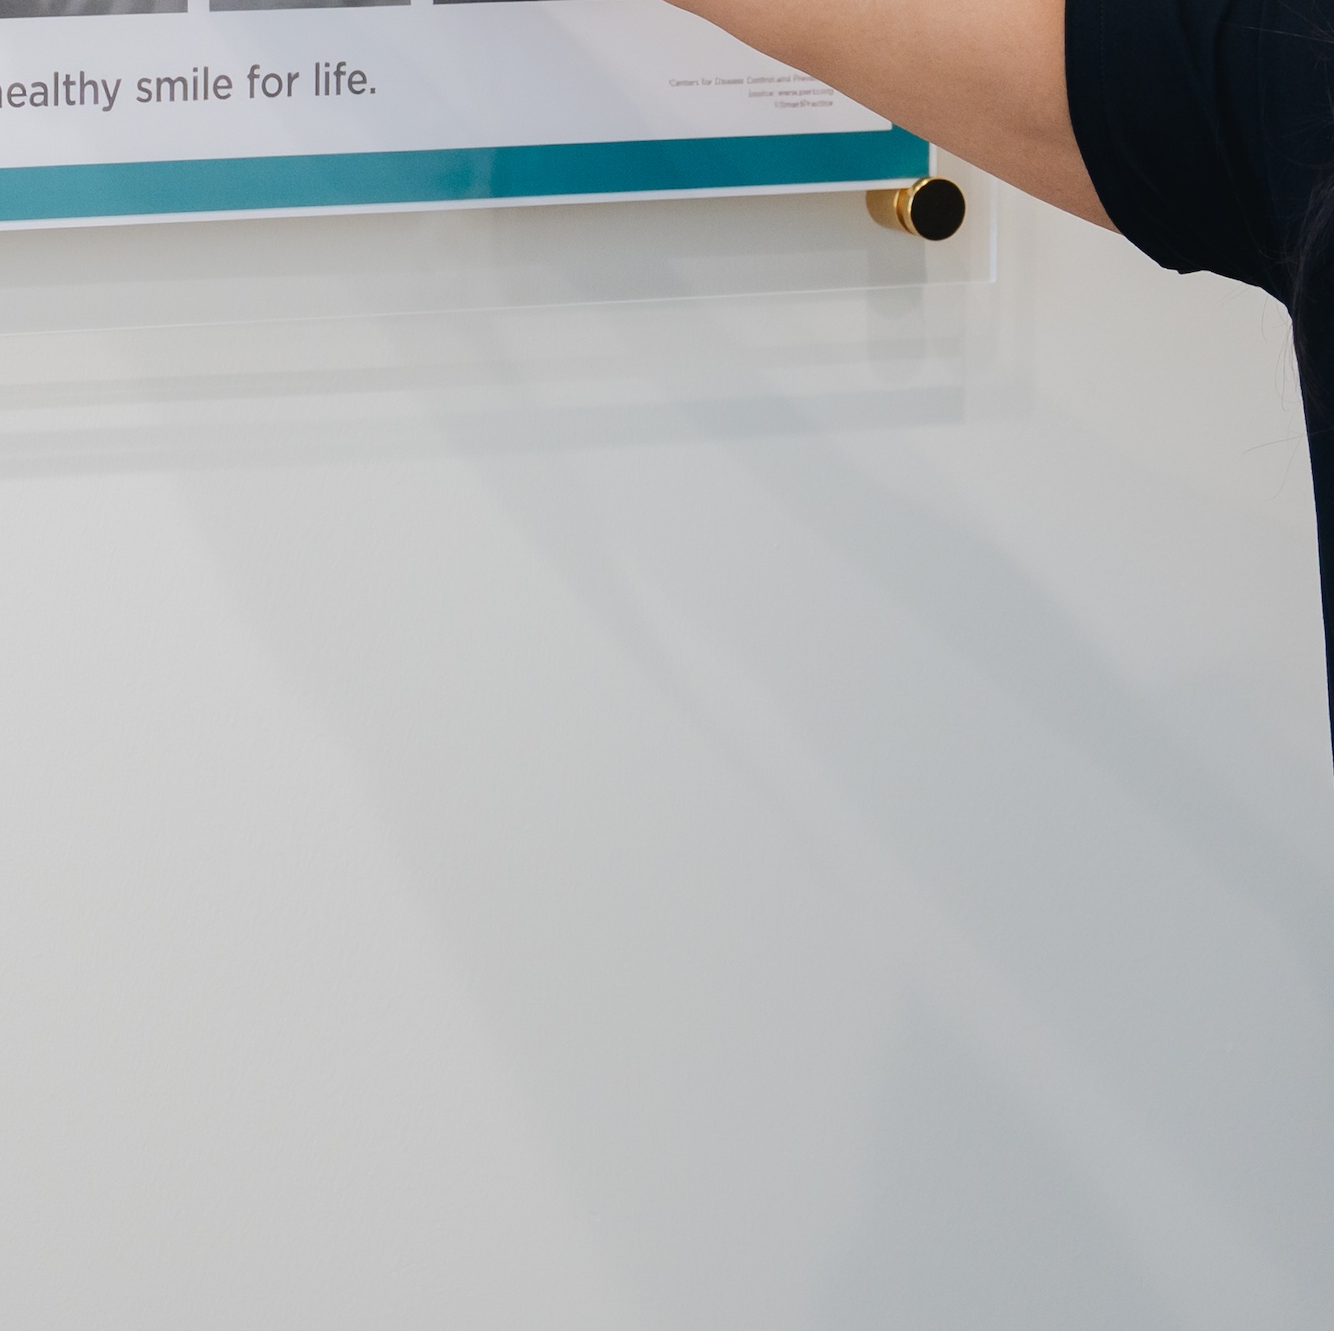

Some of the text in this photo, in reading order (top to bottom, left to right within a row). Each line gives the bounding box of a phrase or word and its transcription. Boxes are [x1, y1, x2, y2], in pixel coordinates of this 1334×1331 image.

[136, 66, 232, 103] smile
[247, 64, 299, 98] for
[315, 62, 375, 96] life.
